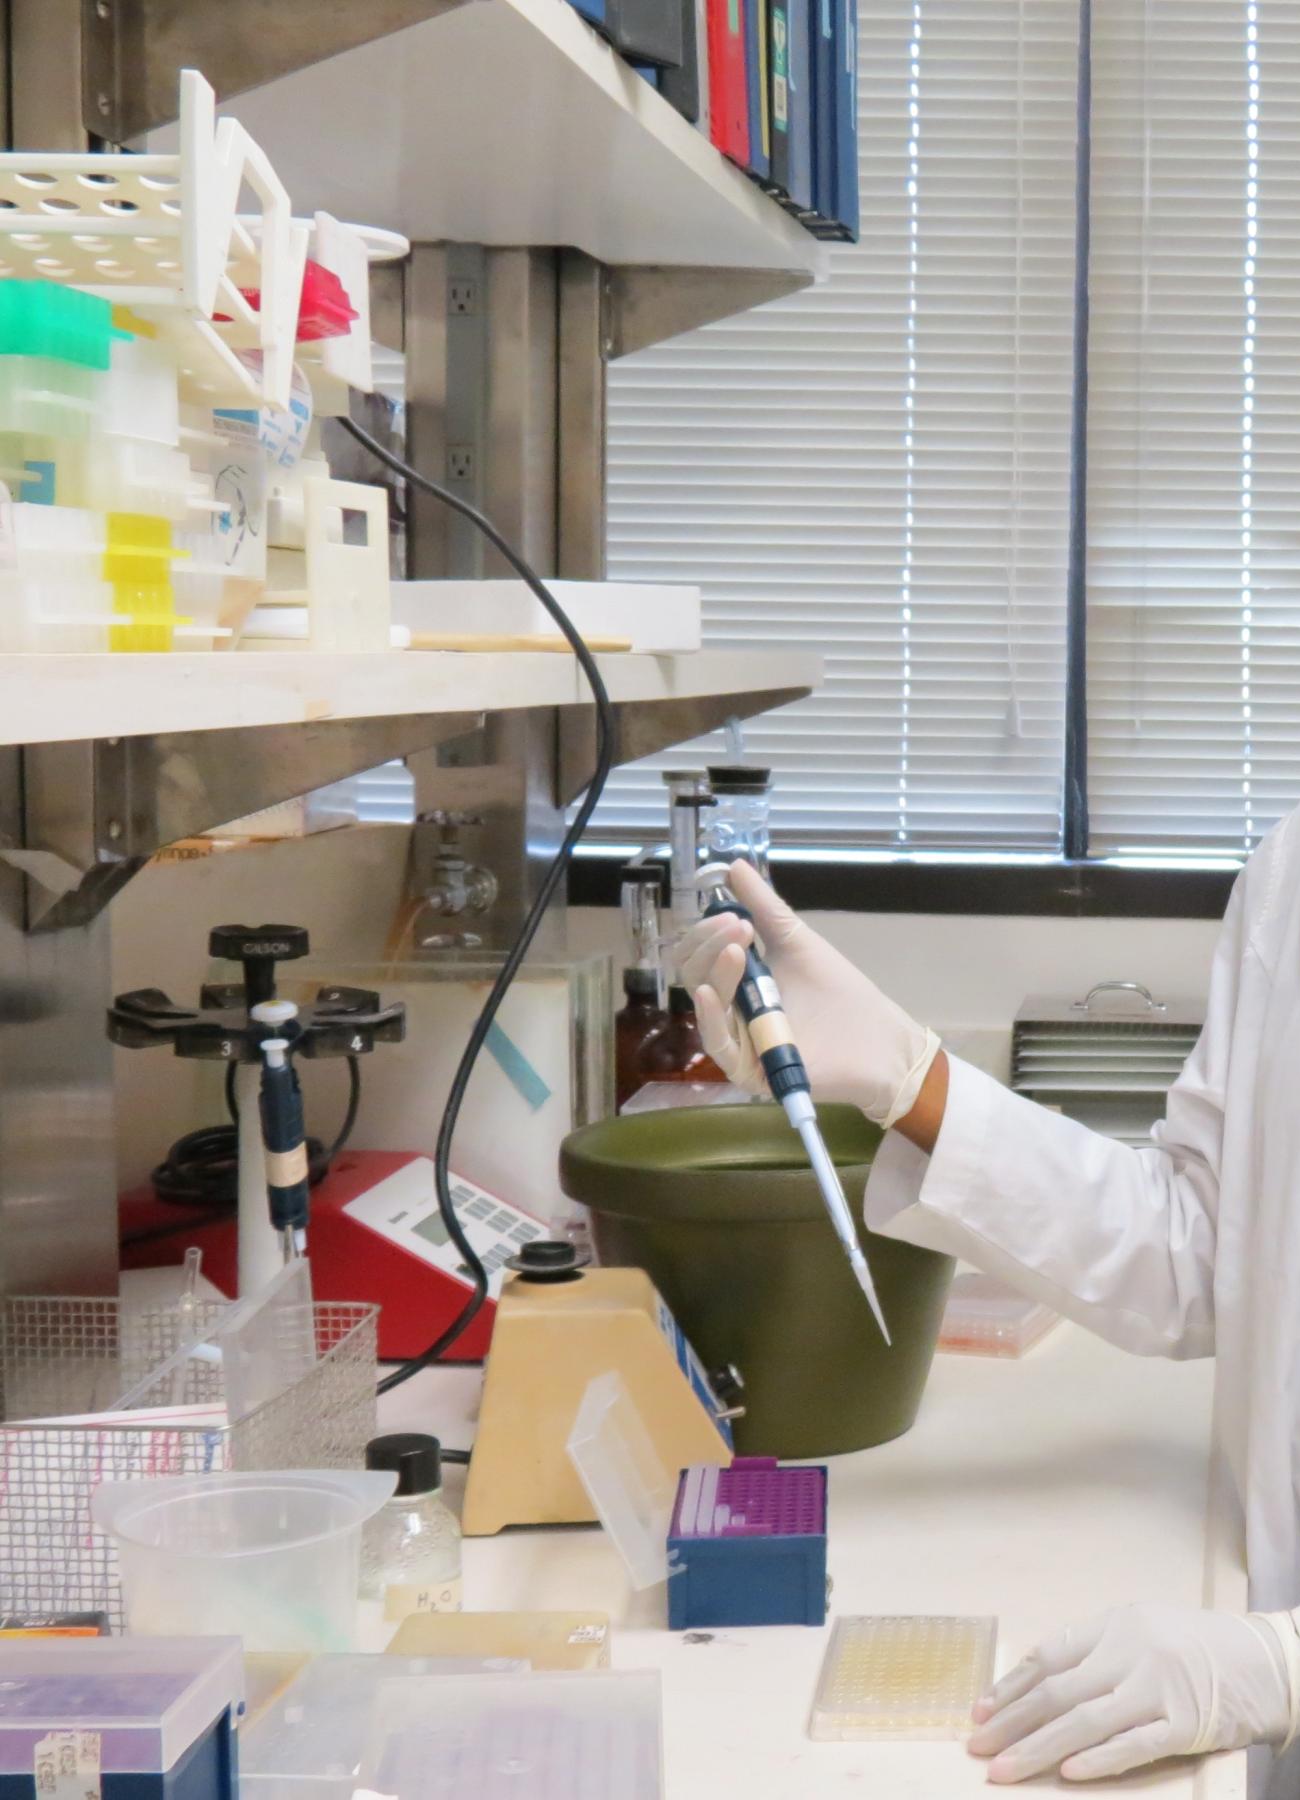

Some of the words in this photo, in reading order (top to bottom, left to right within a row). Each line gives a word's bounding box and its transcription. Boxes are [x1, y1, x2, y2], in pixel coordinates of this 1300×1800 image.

[242, 942, 292, 955] GILSON
[221, 1041, 231, 1056] 3
[351, 1035, 363, 1051] 4
